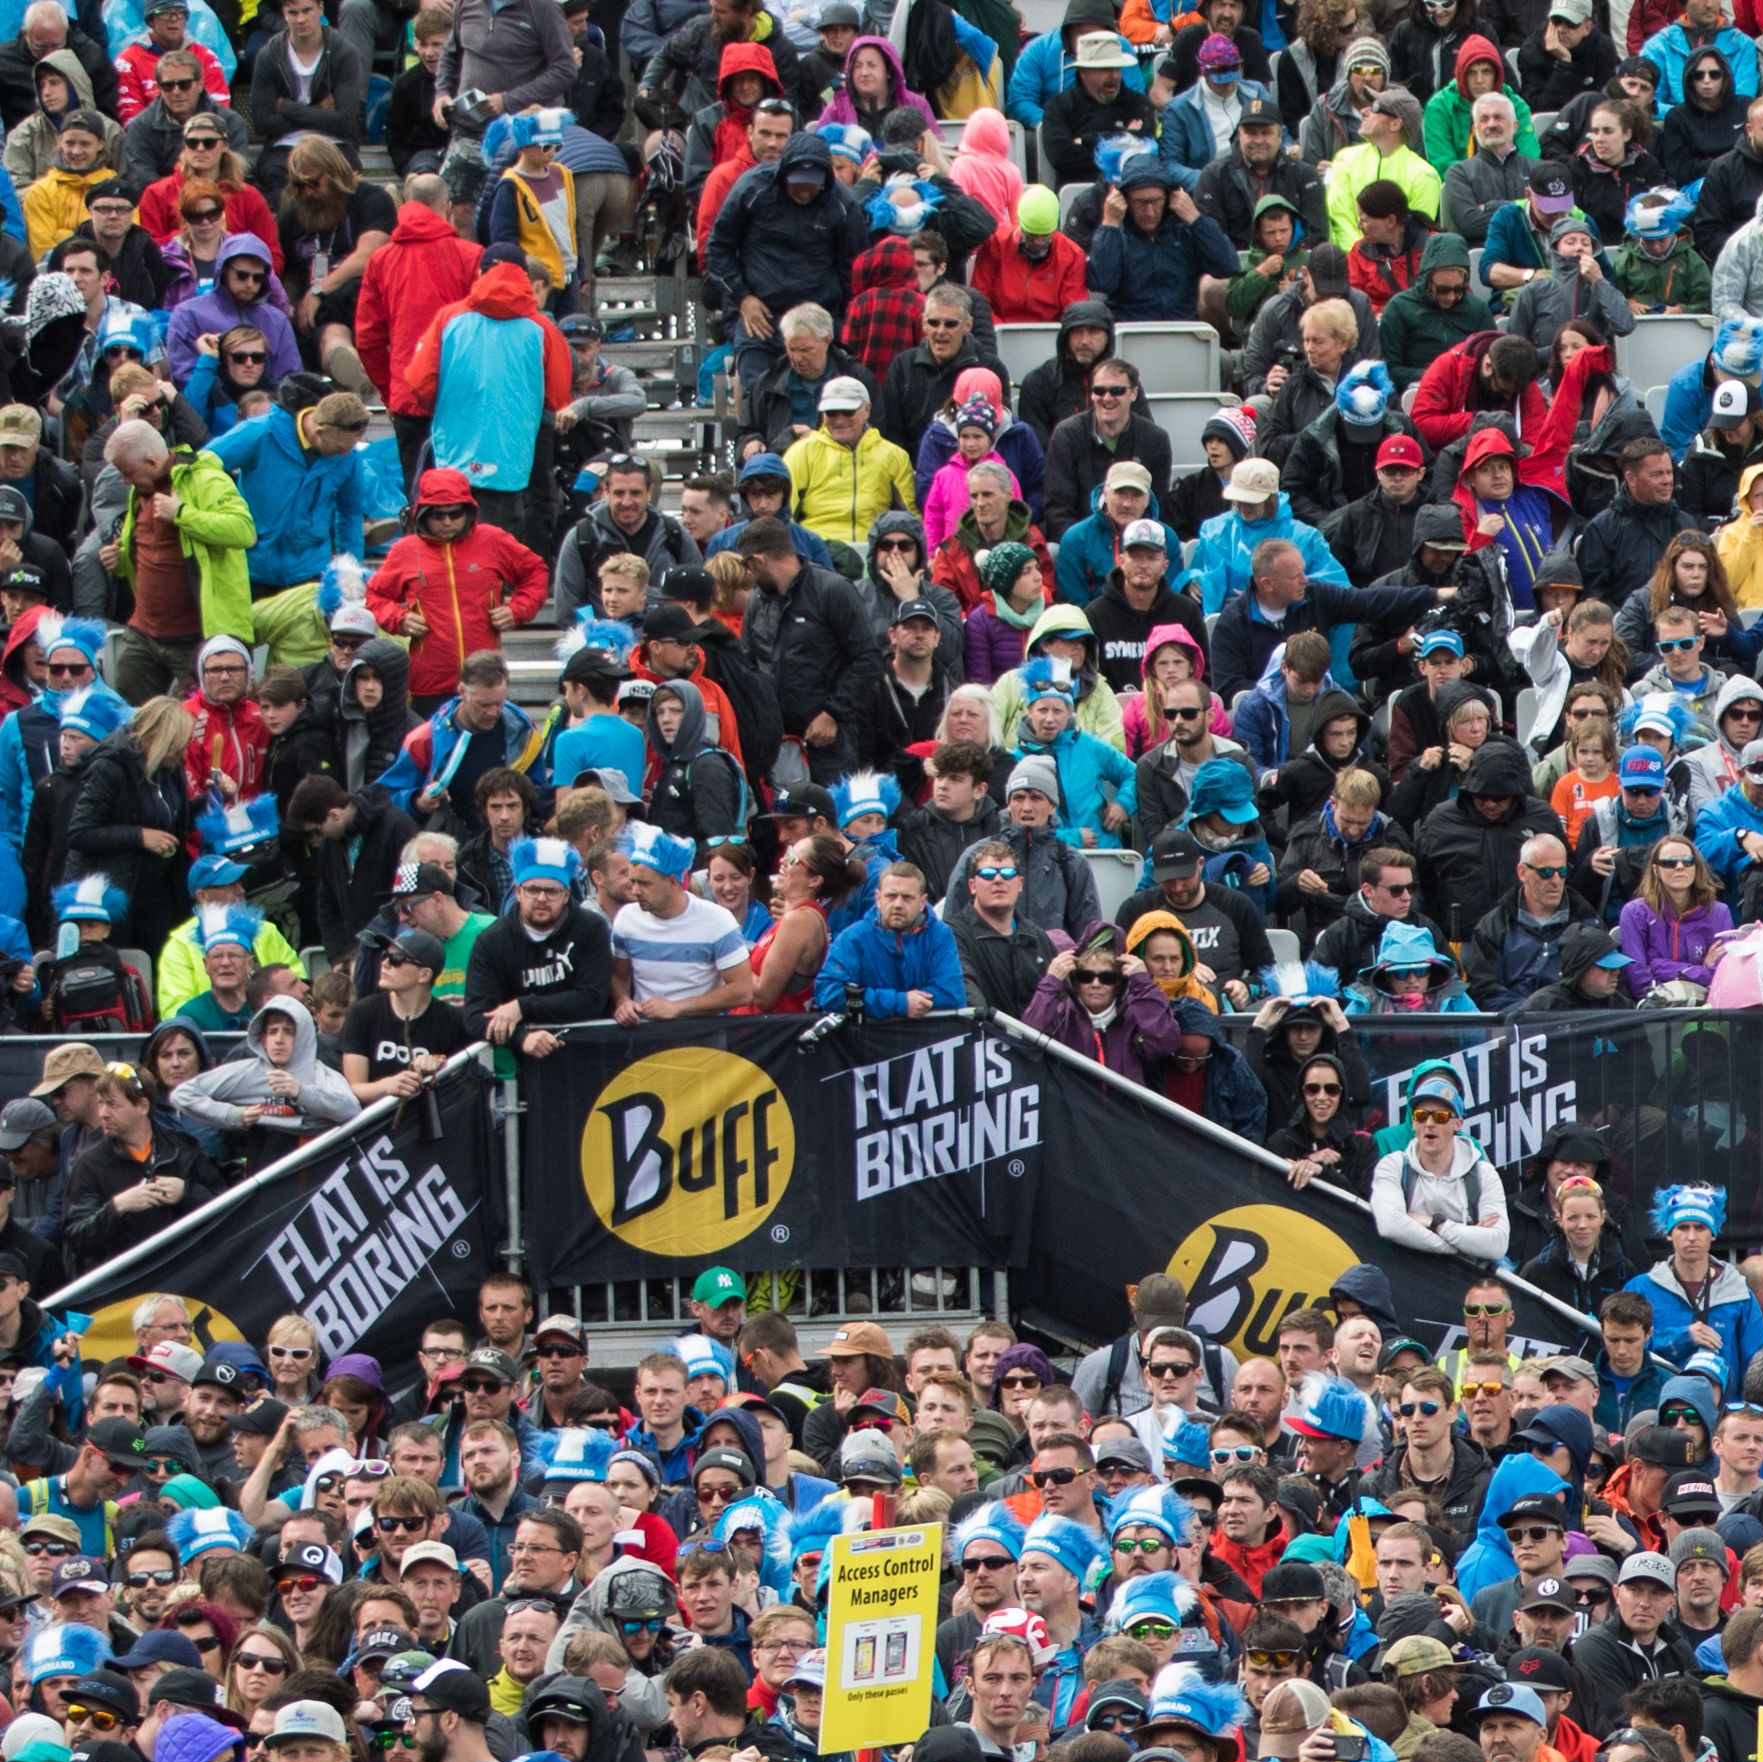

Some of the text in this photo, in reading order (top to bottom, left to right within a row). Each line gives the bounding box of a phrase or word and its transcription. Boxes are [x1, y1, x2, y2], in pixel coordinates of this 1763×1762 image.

[854, 1034, 1014, 1130] FLAT IS
[1511, 1035, 1549, 1086] IS
[856, 1082, 1042, 1201] BORING
[266, 1134, 411, 1298] FLAT IS
[302, 1163, 470, 1353] BORING
[1677, 1484, 1713, 1496] KENDA
[838, 1554, 934, 1583] Access Control
[851, 1584, 918, 1607] Managers
[847, 1687, 908, 1703] Only these passes
